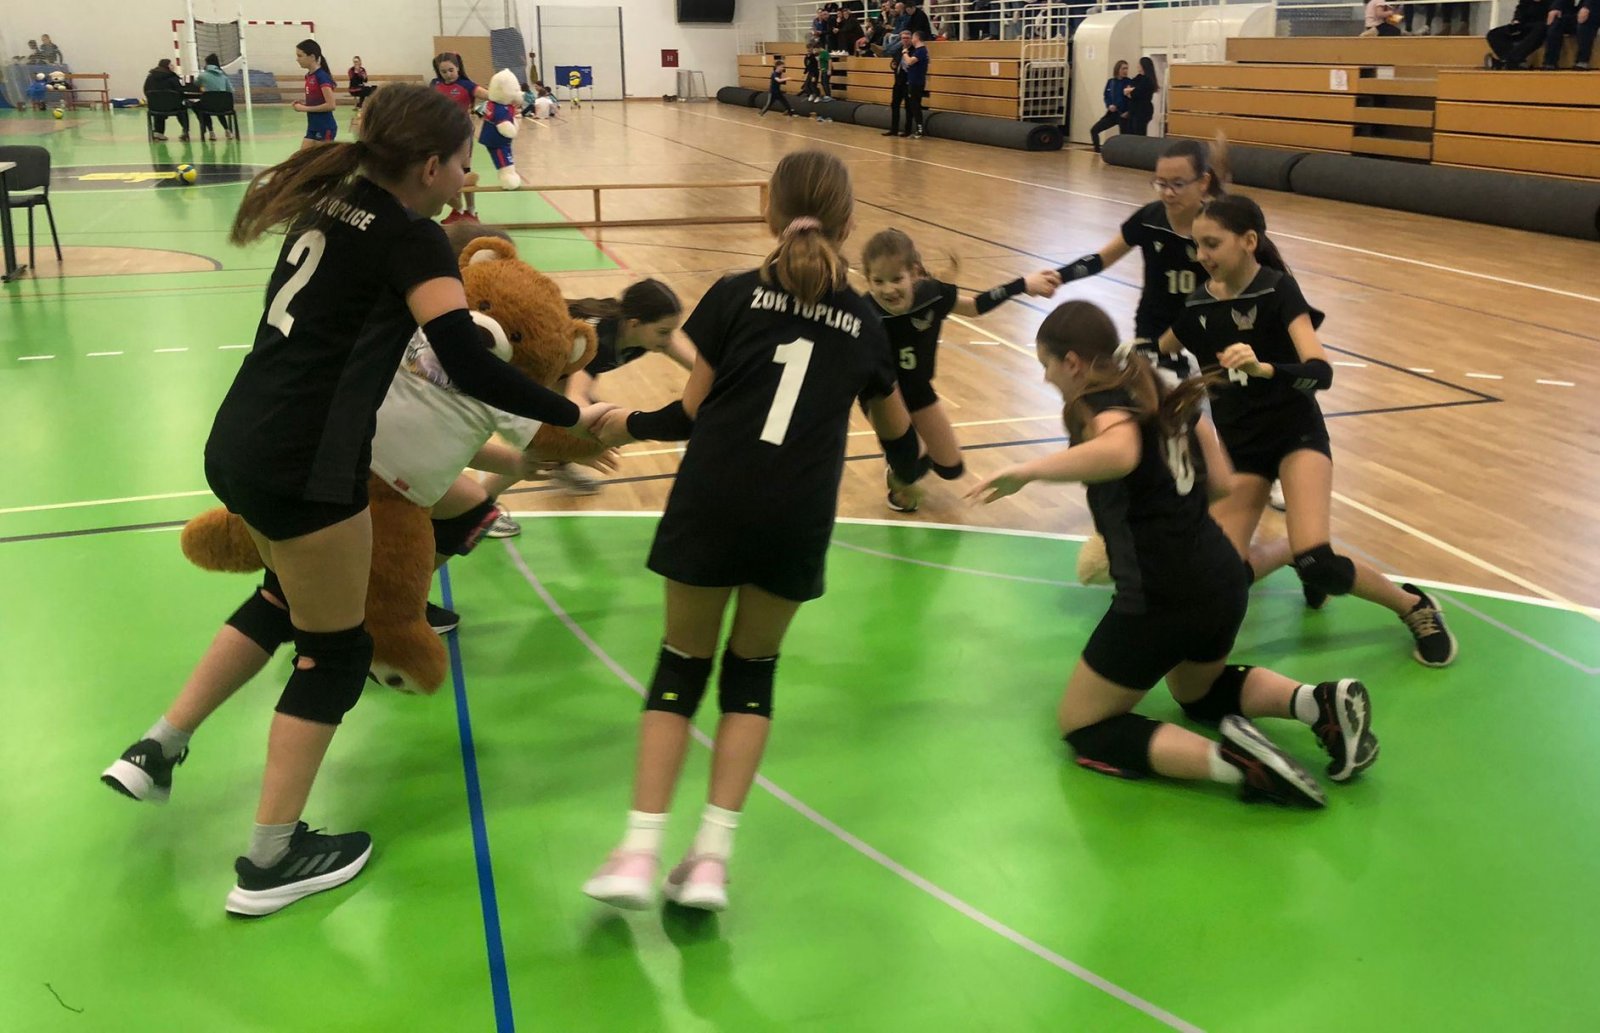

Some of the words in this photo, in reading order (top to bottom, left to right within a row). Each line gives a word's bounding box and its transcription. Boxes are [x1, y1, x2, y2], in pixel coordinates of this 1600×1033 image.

[266, 229, 326, 338] 2
[1164, 269, 1197, 294] 10
[759, 336, 815, 446] 1
[899, 346, 917, 371] 5
